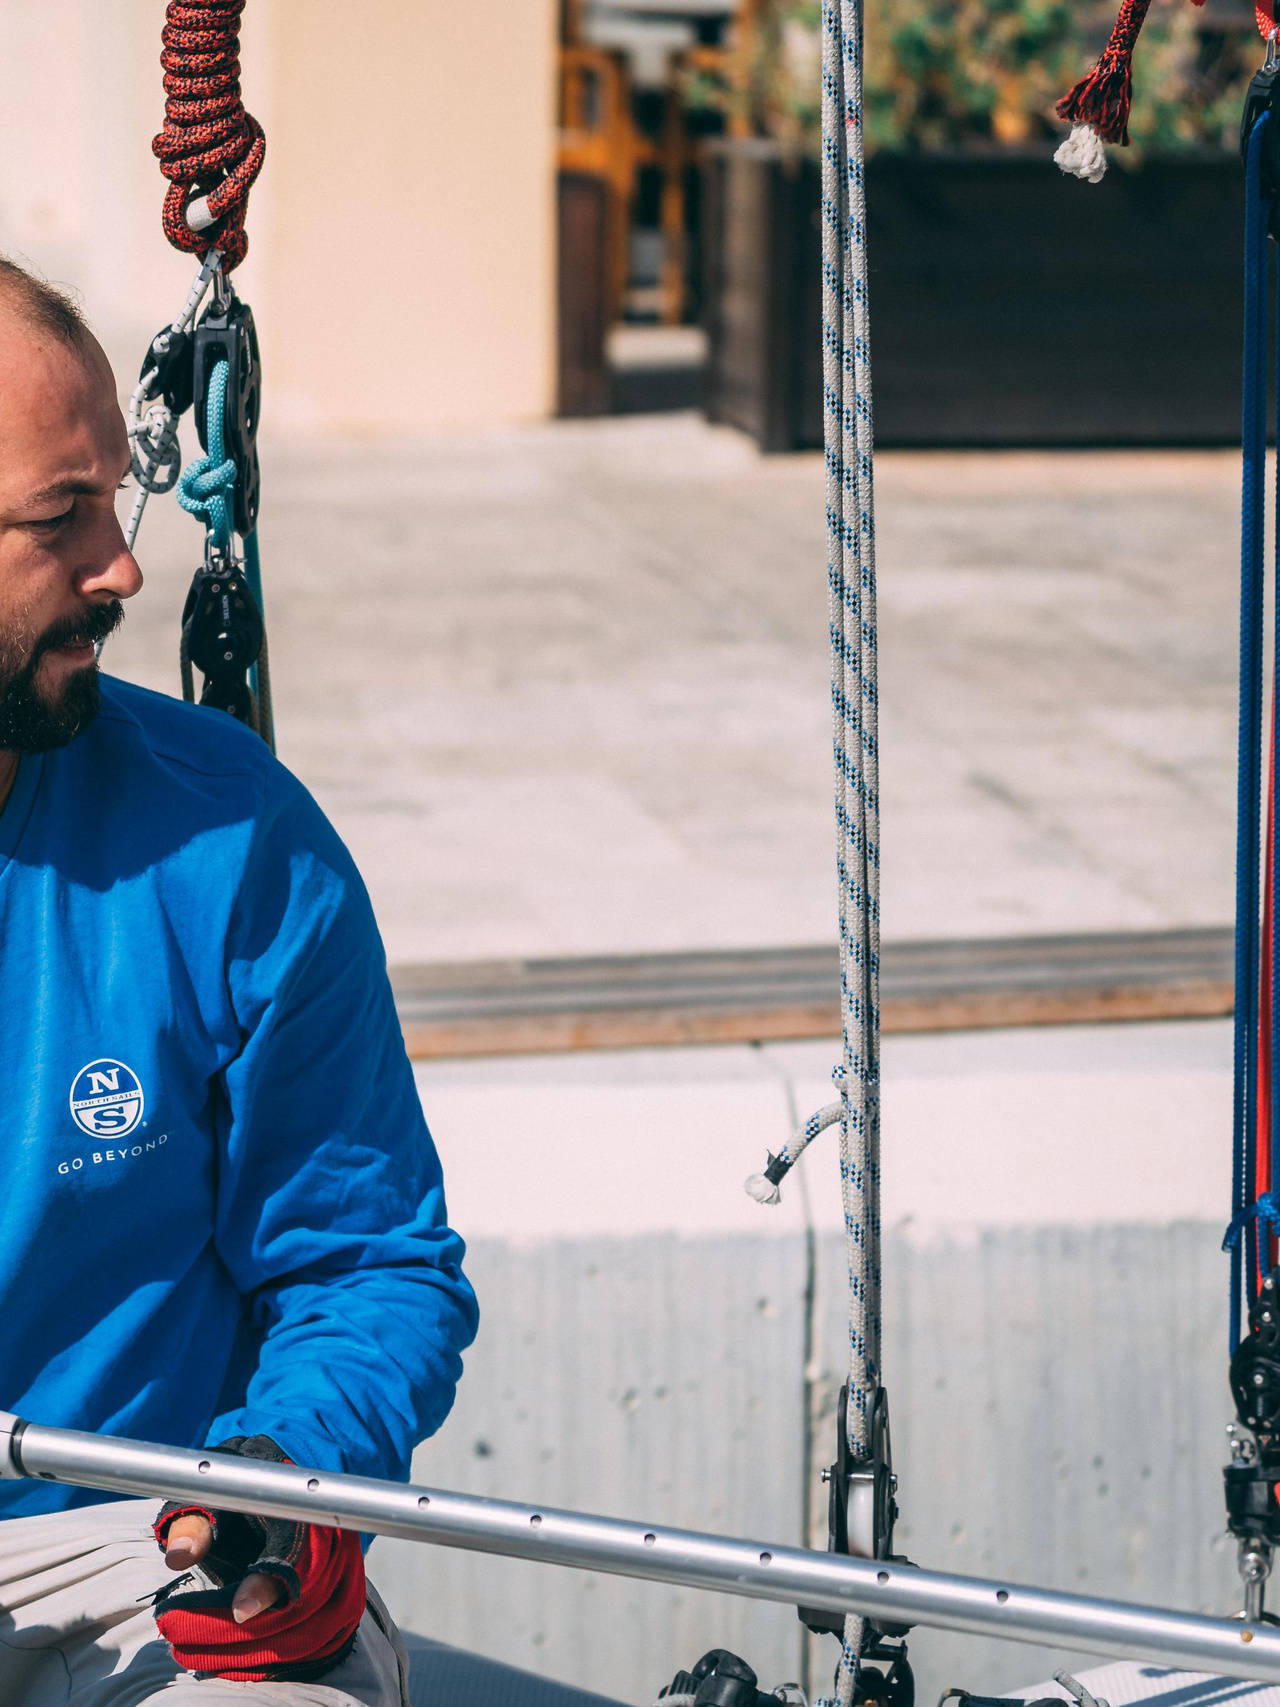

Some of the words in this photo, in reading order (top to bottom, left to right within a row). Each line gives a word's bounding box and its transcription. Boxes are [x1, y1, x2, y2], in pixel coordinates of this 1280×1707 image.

[86, 1067, 120, 1095] N
[93, 1106, 127, 1130] S
[57, 1157, 83, 1175] GO
[92, 1133, 168, 1164] BEYOND
